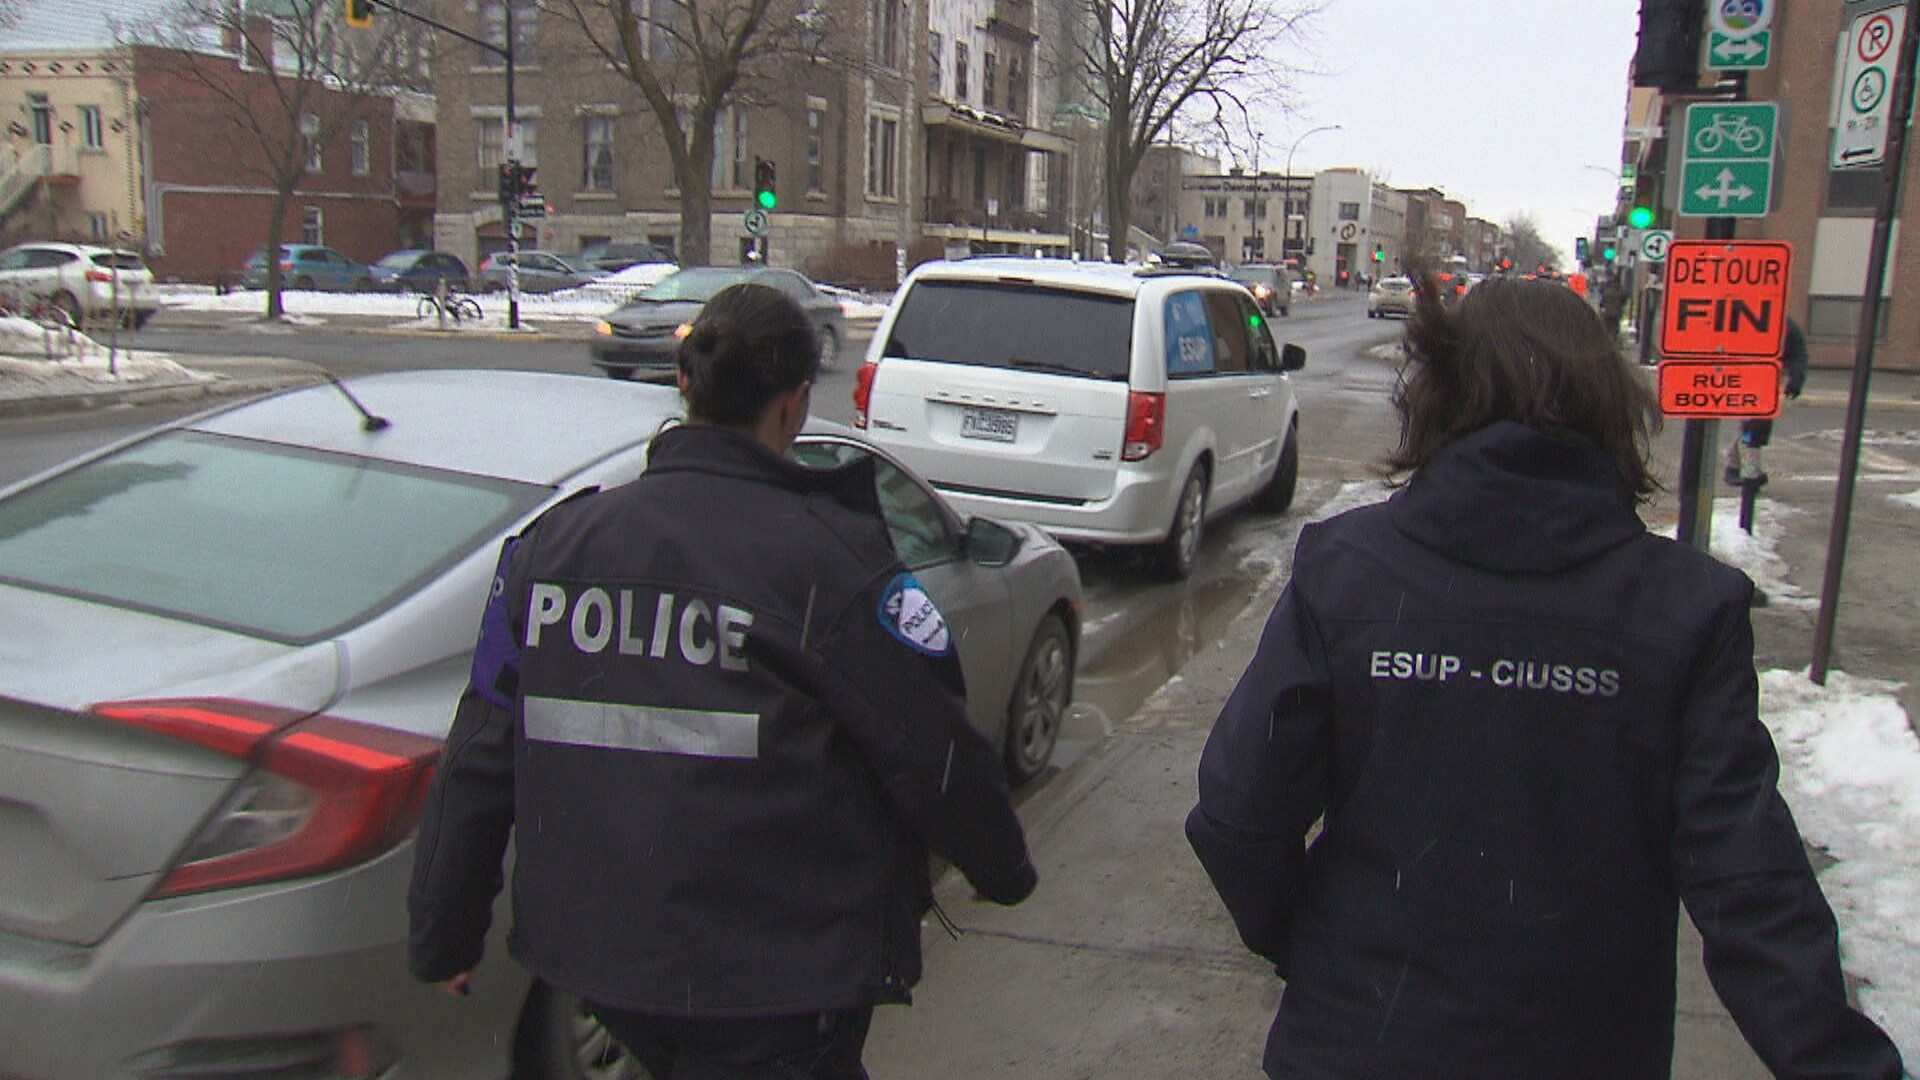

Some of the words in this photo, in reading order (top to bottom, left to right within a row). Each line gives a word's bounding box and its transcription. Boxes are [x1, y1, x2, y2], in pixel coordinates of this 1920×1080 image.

[1674, 253, 1781, 286] DÉTOUR
[1676, 298, 1772, 333] FIN
[1693, 374, 1742, 389] RUE
[1675, 393, 1759, 408] BOYER
[526, 582, 754, 673] POLICE
[1370, 651, 1461, 681] ESUP
[1491, 660, 1620, 696] CIUSSS
